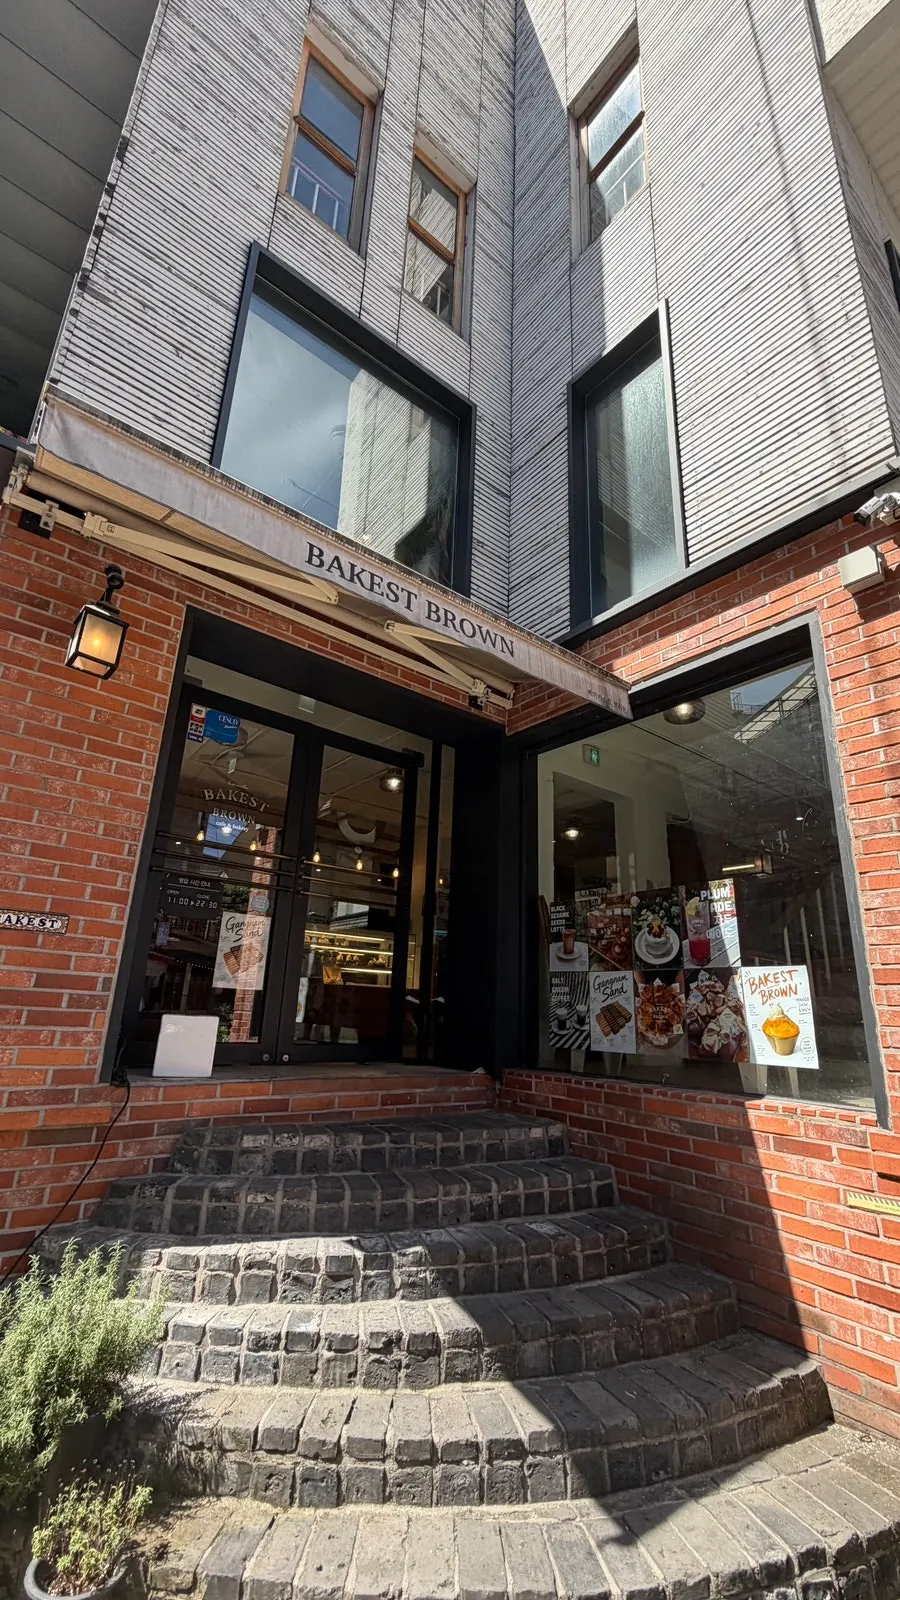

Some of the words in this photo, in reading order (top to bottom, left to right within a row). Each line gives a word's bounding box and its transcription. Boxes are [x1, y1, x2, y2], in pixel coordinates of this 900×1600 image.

[304, 541, 418, 612] BAKEST
[425, 599, 515, 658] BROWN
[203, 788, 269, 812] BAKEST
[212, 807, 256, 824] BROWN
[232, 824, 249, 833] bakery
[700, 886, 731, 900] PLUM
[550, 911, 570, 919] SESAME
[711, 900, 732, 913] ADE
[0, 913, 58, 928] AKEST
[233, 927, 264, 943] Sand
[593, 975, 628, 994] Gangnam
[745, 969, 799, 996] BAKEST
[602, 983, 628, 1003] Sand
[758, 983, 798, 1006] BROWN
